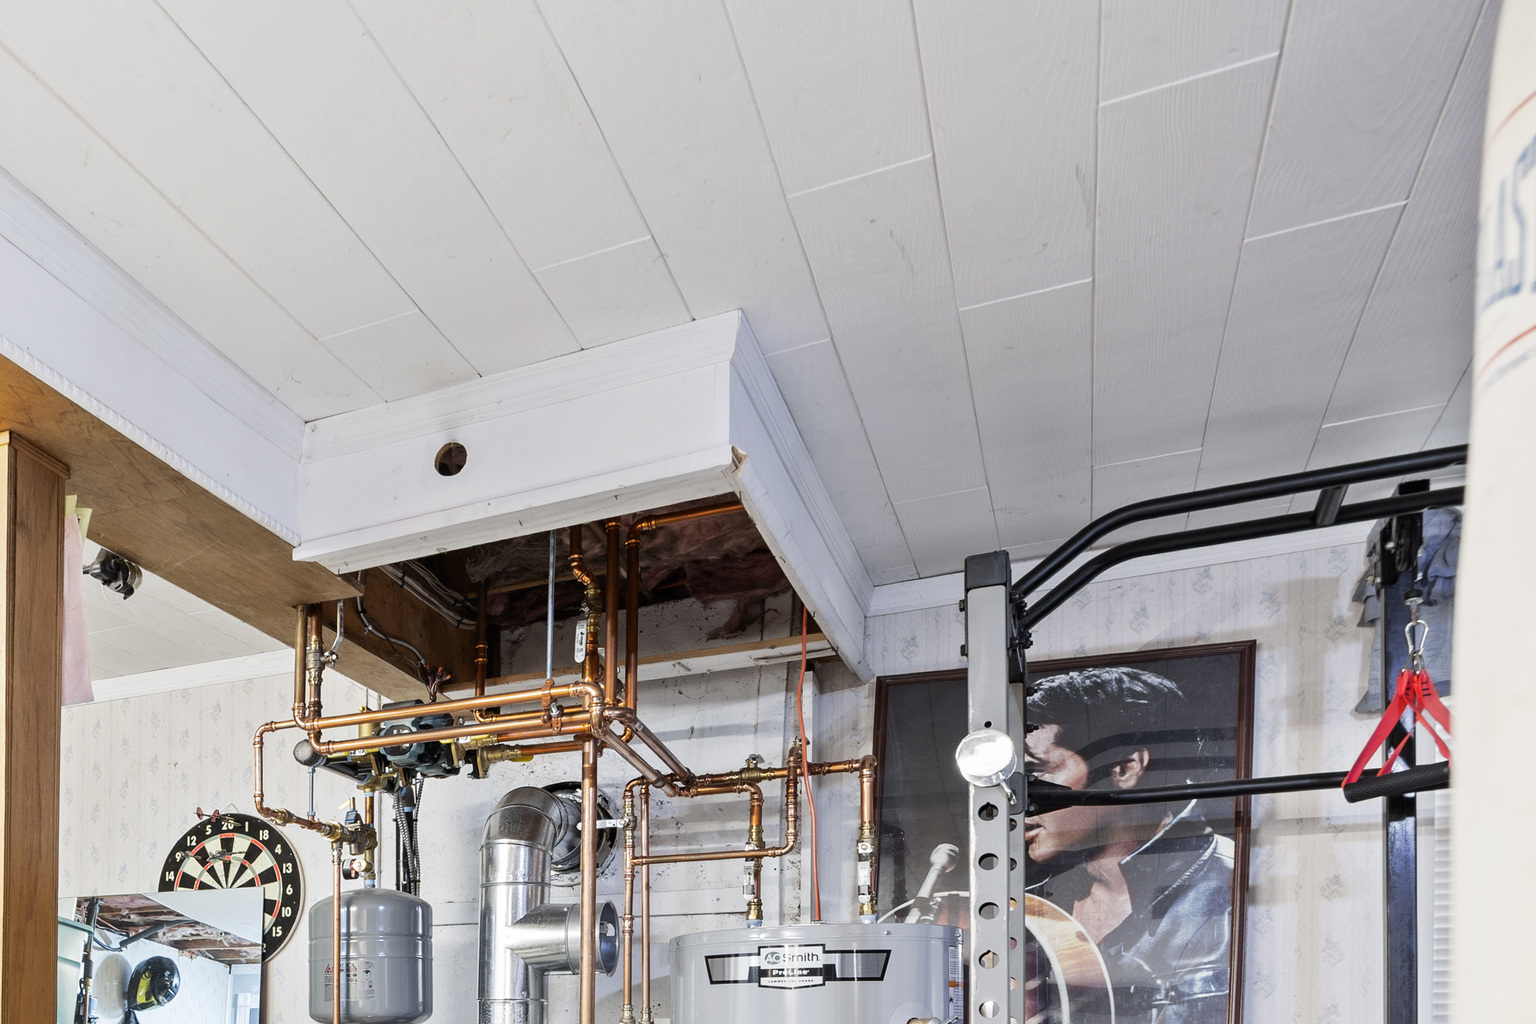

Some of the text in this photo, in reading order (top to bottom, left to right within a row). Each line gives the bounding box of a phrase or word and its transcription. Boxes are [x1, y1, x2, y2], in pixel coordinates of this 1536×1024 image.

[205, 825, 212, 835] 5
[221, 821, 234, 830] 20
[244, 821, 249, 832] 1
[186, 835, 197, 846] 12
[259, 829, 269, 841] 18
[274, 843, 282, 855] 4
[175, 852, 182, 862] 9
[282, 862, 293, 874] 13
[165, 870, 175, 882] 14
[286, 884, 293, 895] 6
[281, 906, 292, 918] 10
[272, 926, 283, 937] 15
[782, 951, 820, 963] Smith
